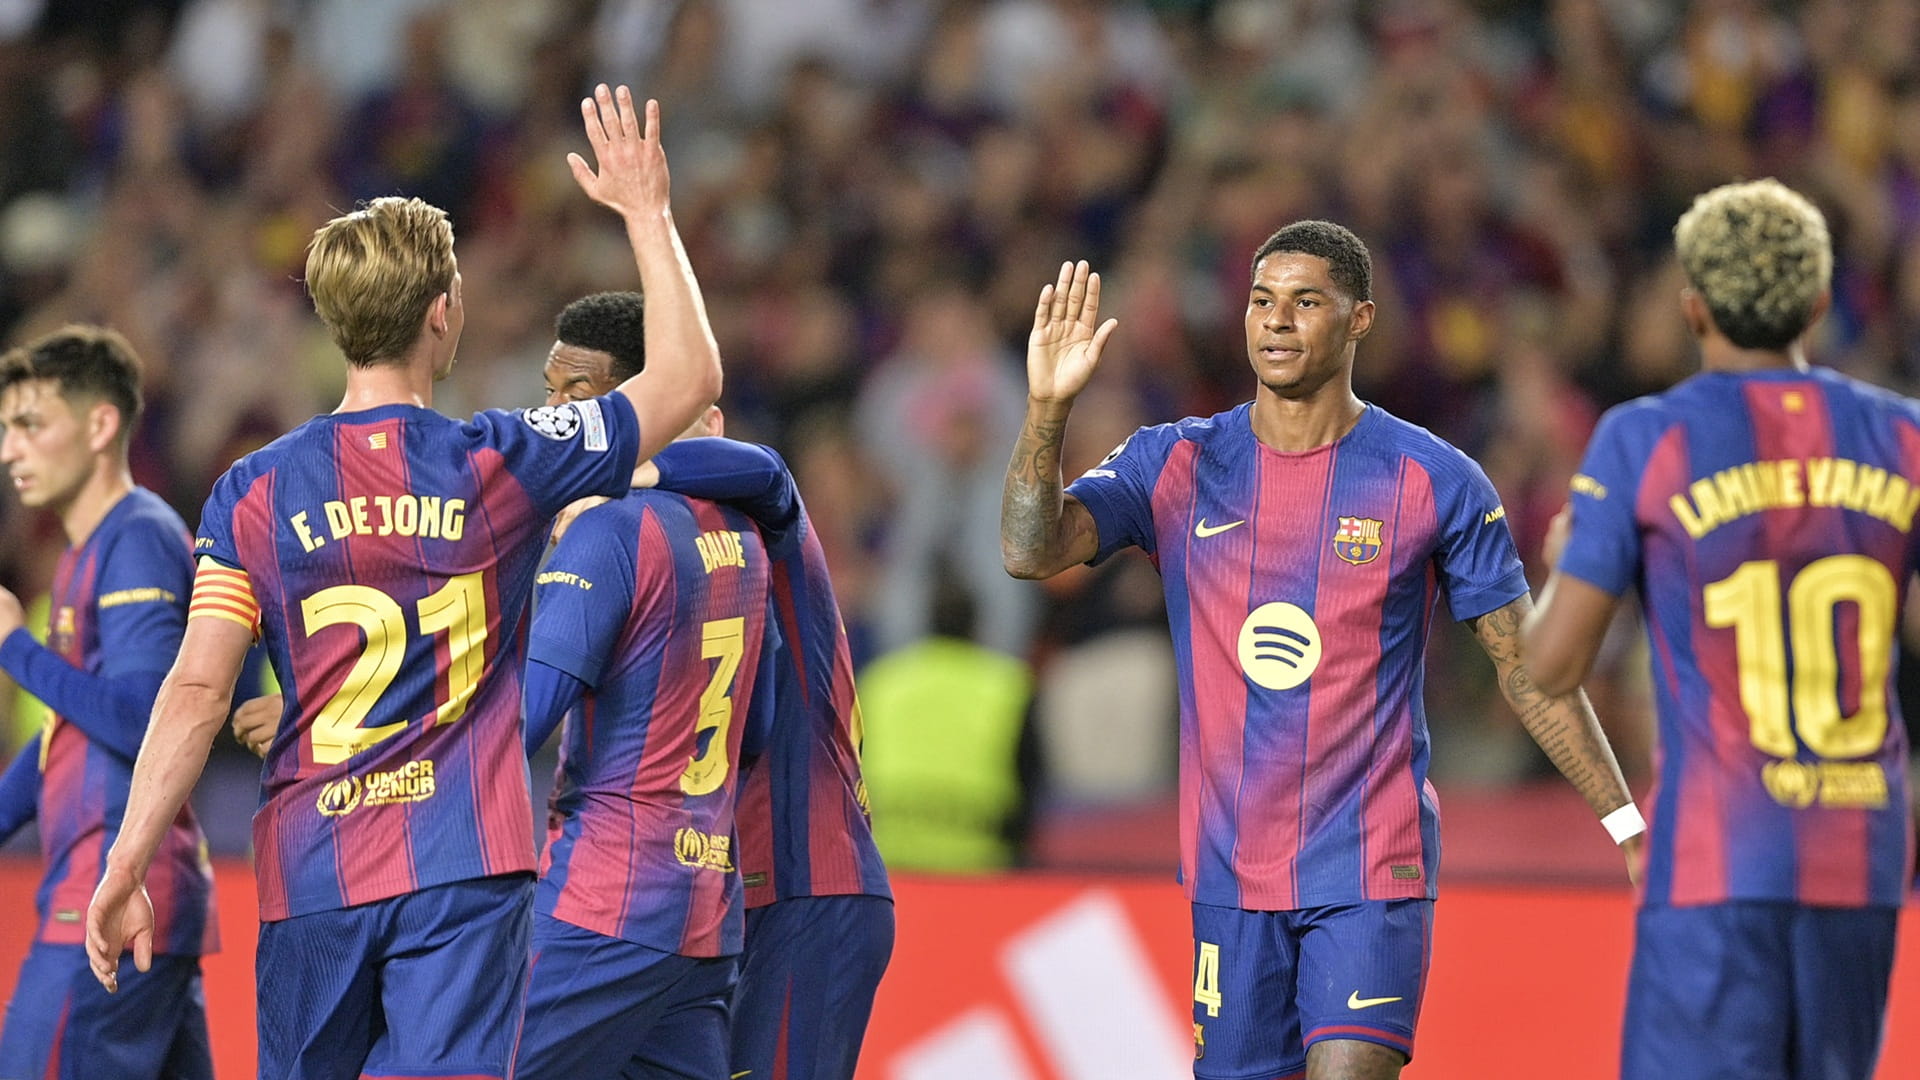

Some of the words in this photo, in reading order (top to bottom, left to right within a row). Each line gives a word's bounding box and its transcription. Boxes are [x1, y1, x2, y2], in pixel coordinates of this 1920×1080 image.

[290, 510, 326, 553] F.
[324, 496, 373, 540] DE
[375, 495, 465, 541] JONG
[1669, 459, 1803, 539] LAMINE
[695, 530, 746, 574] BALDE
[301, 571, 488, 765] 21
[1704, 554, 1897, 759] 10
[679, 617, 744, 795] 3
[1193, 940, 1221, 1017] 4
